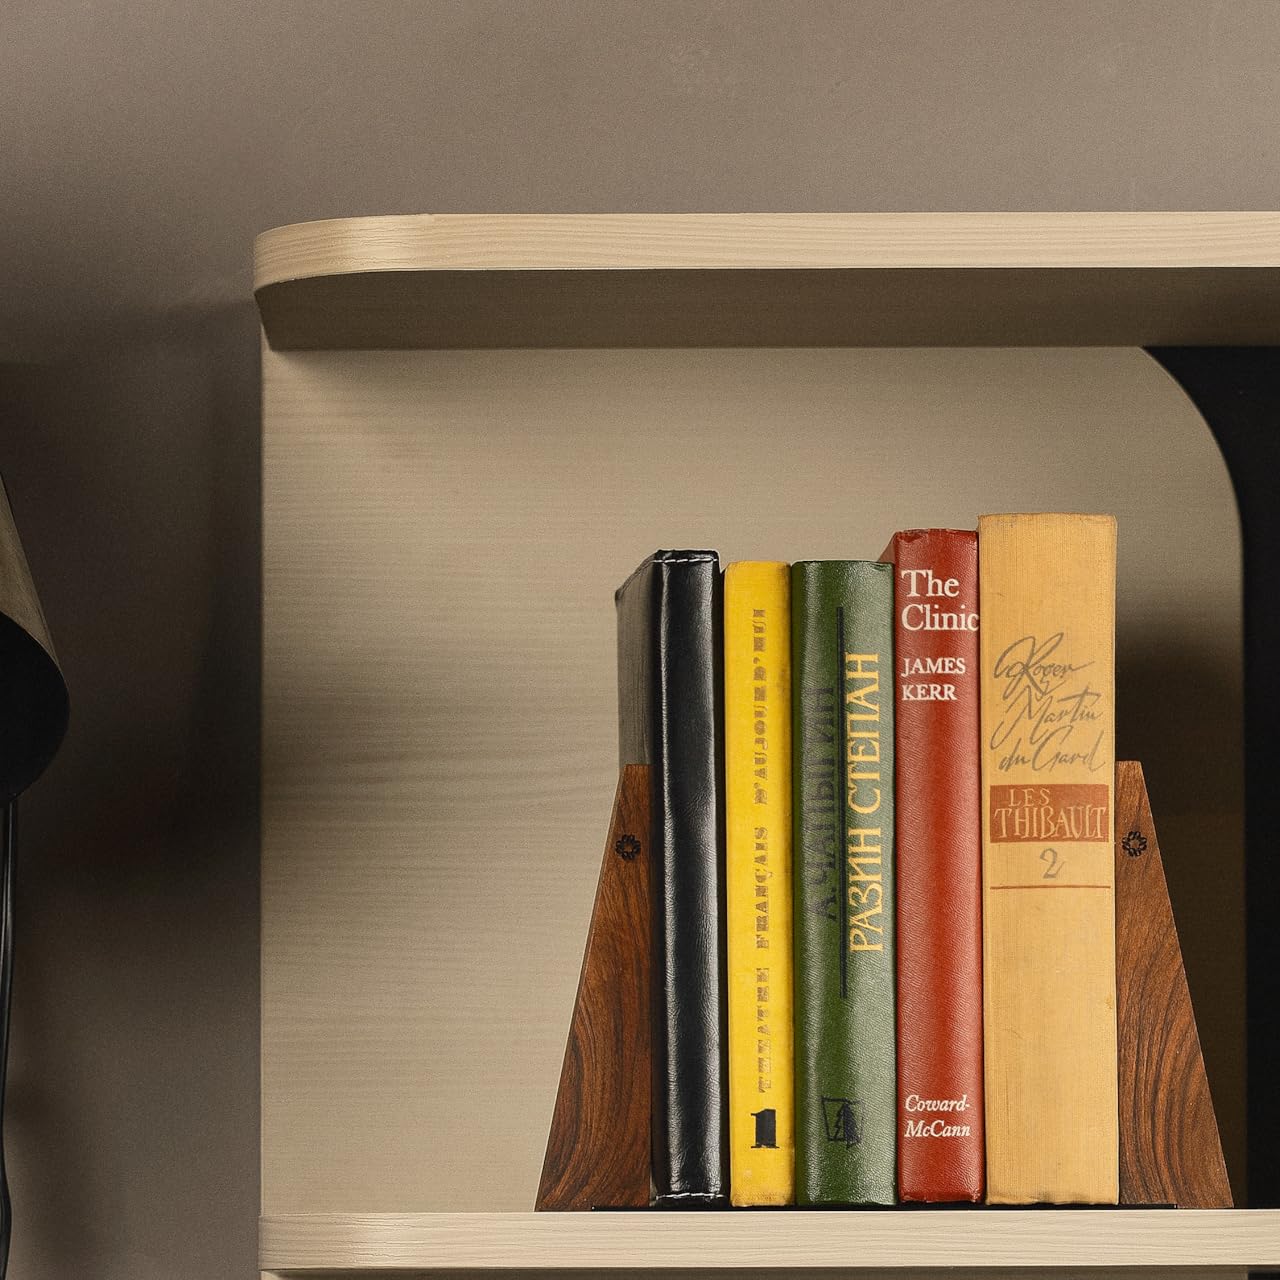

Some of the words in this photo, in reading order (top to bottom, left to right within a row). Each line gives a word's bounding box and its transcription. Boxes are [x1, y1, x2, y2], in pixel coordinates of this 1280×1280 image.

[901, 569, 960, 598] The
[901, 603, 979, 632] Clinic
[901, 657, 966, 678] JAMES
[993, 632, 1095, 701] Roger
[902, 683, 957, 701] KERR
[845, 652, 882, 814] СТЕПАН
[989, 684, 1103, 750] Martin
[997, 738, 1031, 772] du
[1031, 725, 1106, 772] Gard
[1009, 787, 1051, 808] LES
[994, 804, 1107, 841] THIBAULT
[1039, 847, 1066, 880] 2
[754, 827, 772, 949] FRANÇAIS
[847, 826, 884, 953] РАЗИН
[905, 1094, 970, 1112] Coward-
[751, 1107, 779, 1150] 1
[904, 1119, 971, 1137] McCann
